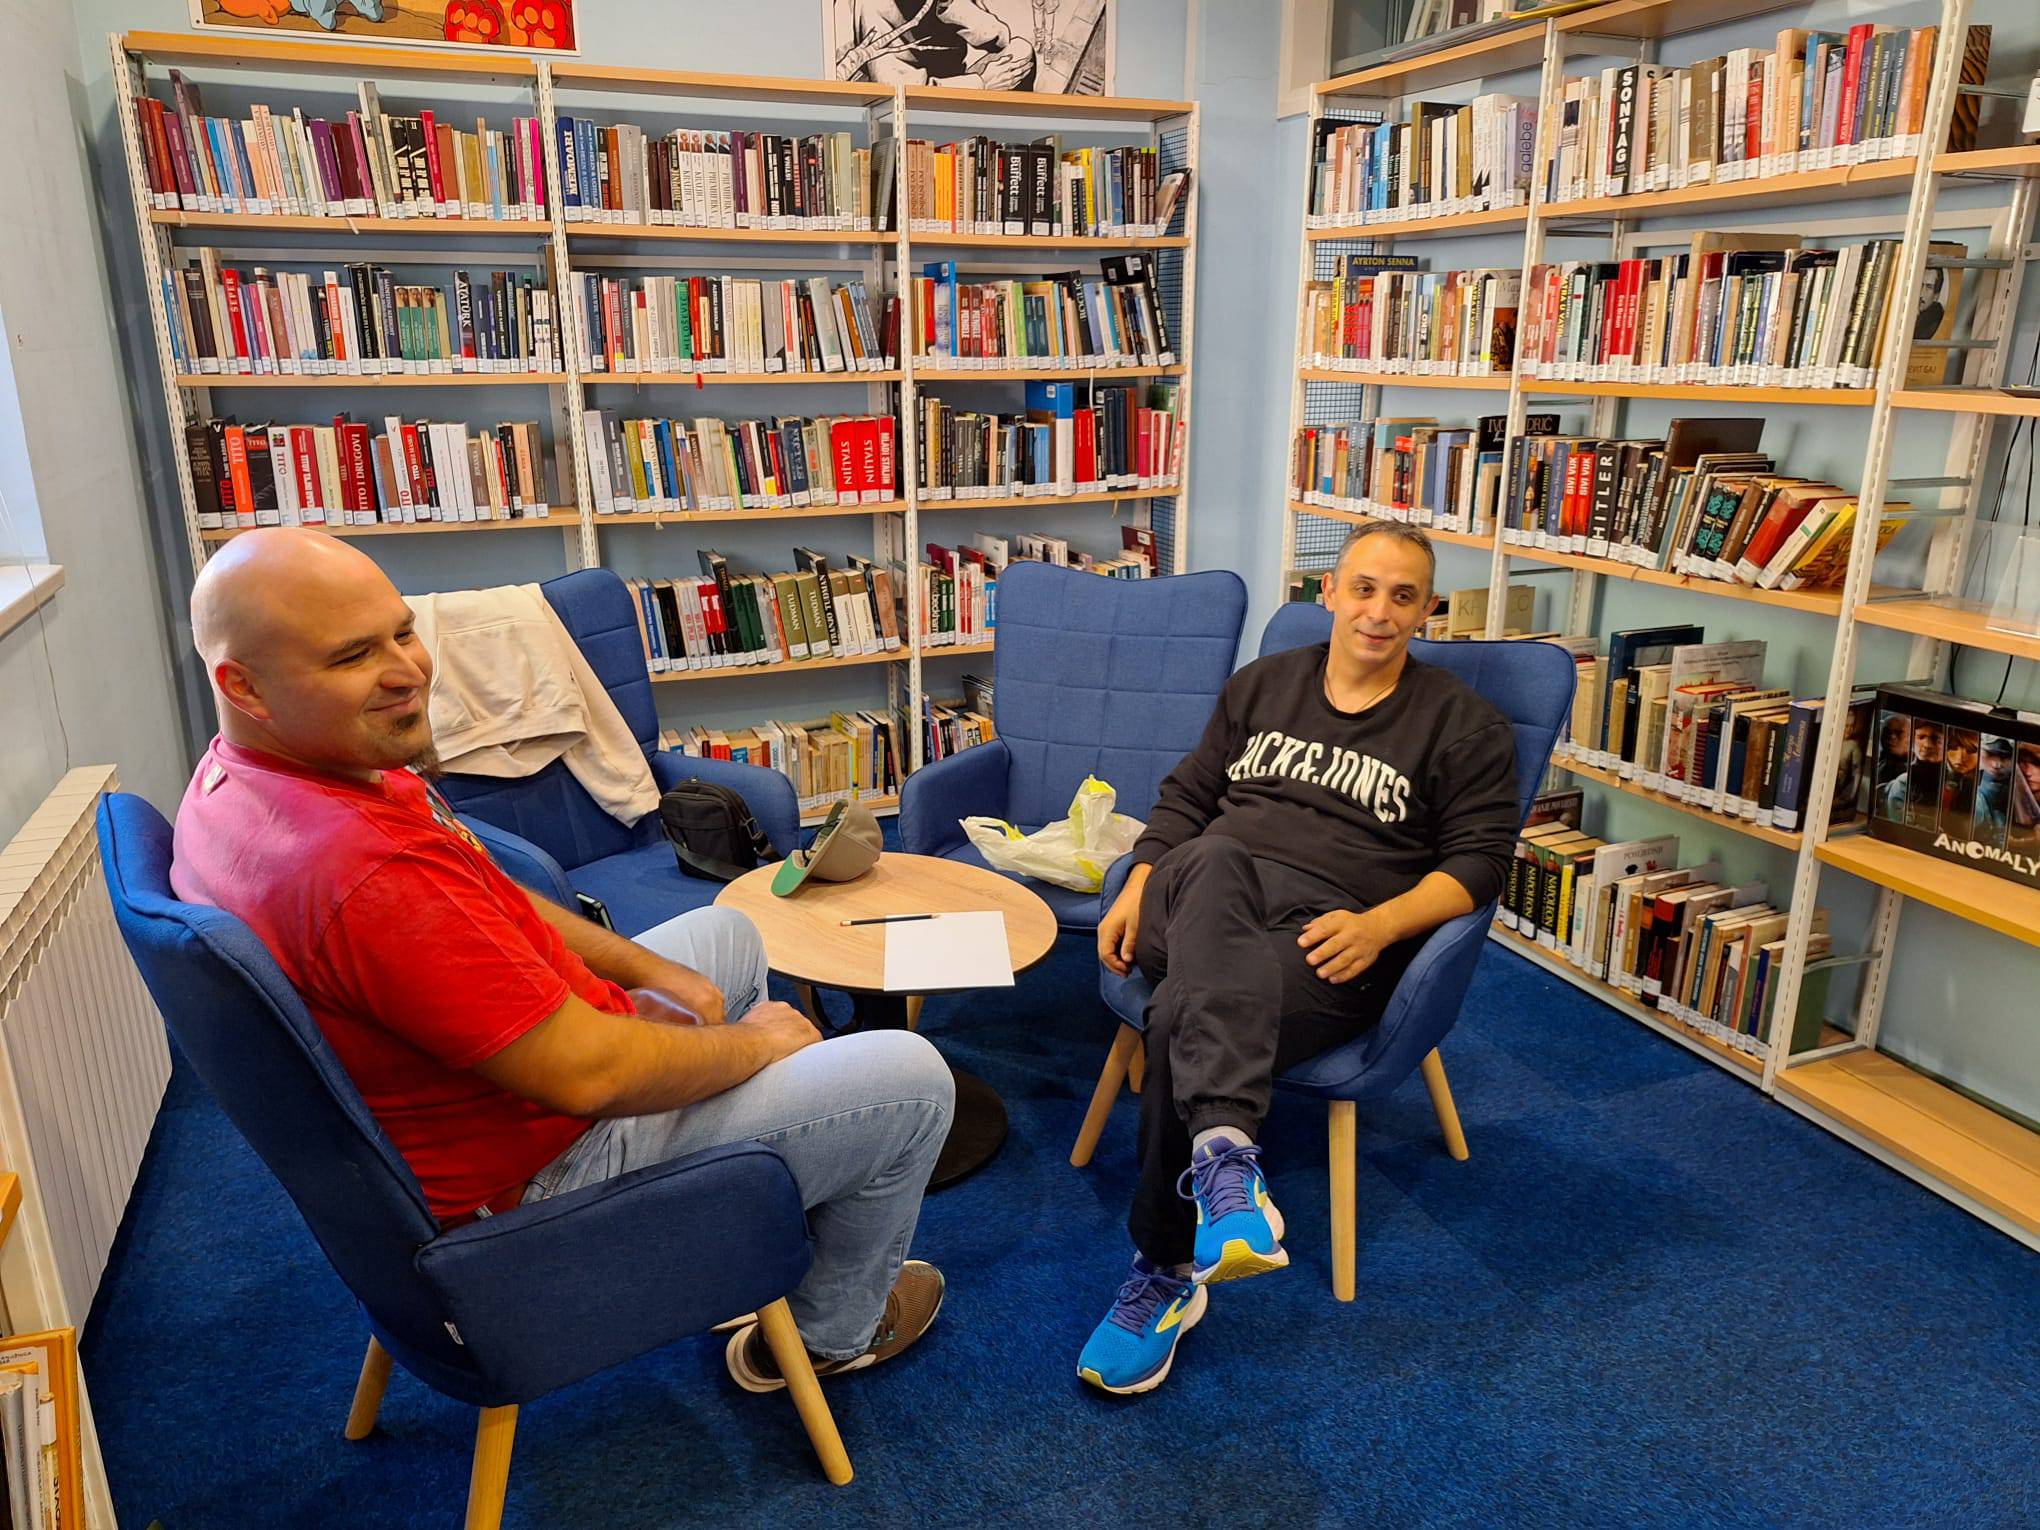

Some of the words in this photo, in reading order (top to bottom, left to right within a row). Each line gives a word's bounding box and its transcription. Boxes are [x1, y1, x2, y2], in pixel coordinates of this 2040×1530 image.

[1615, 70, 1634, 164] SONTAG
[563, 130, 579, 196] MEMOARI
[1009, 155, 1021, 198] Buffett
[1036, 156, 1047, 198] Buffett
[1352, 256, 1385, 266] AYRTON
[1387, 256, 1415, 266] SENNA
[459, 280, 472, 328] ATATÜRK
[1616, 307, 1624, 329] Braun
[1627, 307, 1636, 329] Braun
[681, 295, 690, 351] MILOŠEVIĆ
[961, 309, 970, 339] MENGELE
[972, 309, 981, 339] MENGELE
[1645, 301, 1654, 352] CASANOVA
[212, 423, 221, 433] V
[230, 436, 244, 465] TITO
[249, 439, 266, 447] TITO
[353, 433, 365, 480] DRUGOVI
[880, 432, 890, 456] MLADI
[276, 452, 288, 475] TITO
[412, 463, 420, 481] TITO
[840, 440, 853, 485] STALJIN
[863, 439, 875, 483] STALJIN
[881, 457, 891, 485] STALJIN
[1568, 456, 1580, 474] VUK
[1582, 456, 1594, 474] VUK
[221, 480, 235, 507] TITO
[357, 487, 369, 511] TITO
[400, 490, 412, 506] ITO
[1566, 475, 1576, 495] SIVI
[1579, 475, 1589, 496] SIVI
[1593, 455, 1614, 540] HITLER
[825, 611, 838, 644] FRANJO
[1933, 832, 2040, 877] ANOMALY
[1521, 865, 1537, 918] NAPOLEON
[1544, 874, 1558, 927] NAPOLEON
